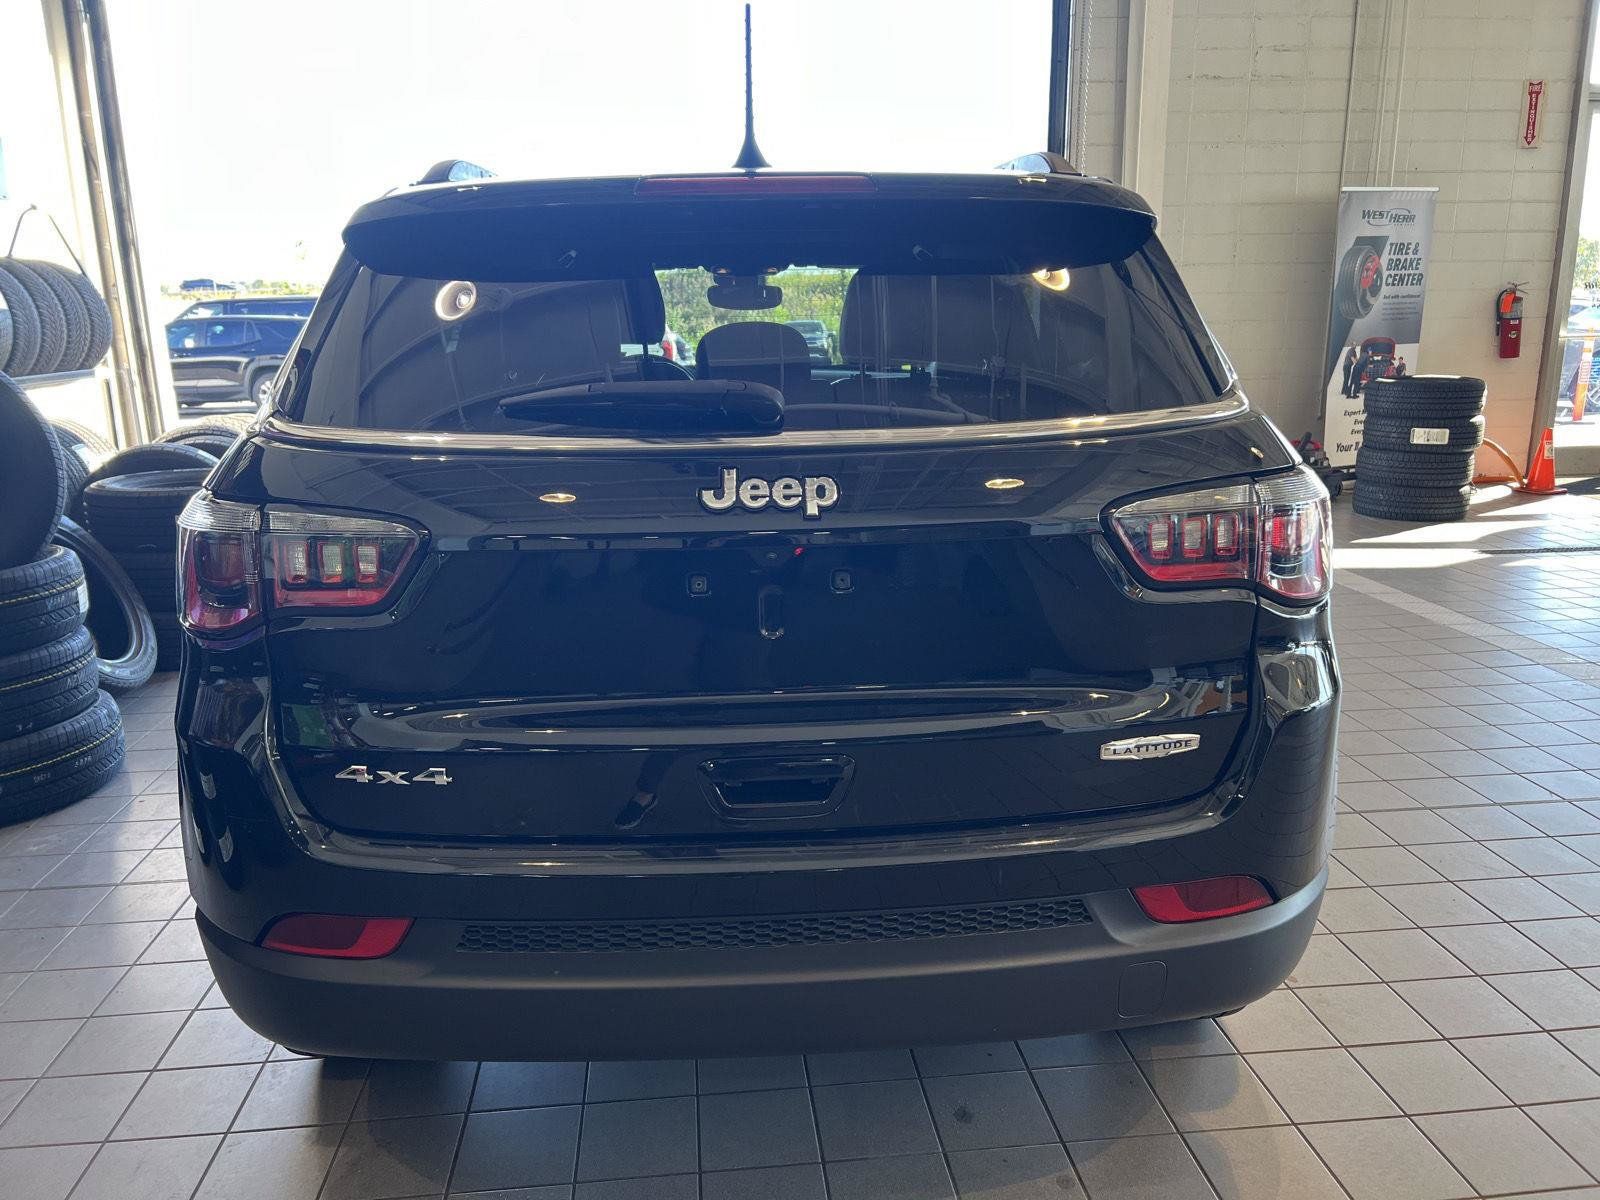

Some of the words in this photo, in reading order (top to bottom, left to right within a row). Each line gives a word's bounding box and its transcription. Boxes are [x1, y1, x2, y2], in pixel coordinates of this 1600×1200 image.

[1362, 209, 1391, 220] WEST
[1389, 212, 1416, 224] HERR
[1388, 242, 1411, 256] TIRE
[1412, 242, 1420, 256] &
[1386, 258, 1422, 272] BRAKE
[1385, 273, 1424, 287] CENTER
[1343, 409, 1361, 417] Expert
[1336, 442, 1353, 453] Your
[701, 467, 838, 516] Jeep
[1112, 739, 1193, 756] LATITUDE
[335, 765, 453, 786] 4x4
